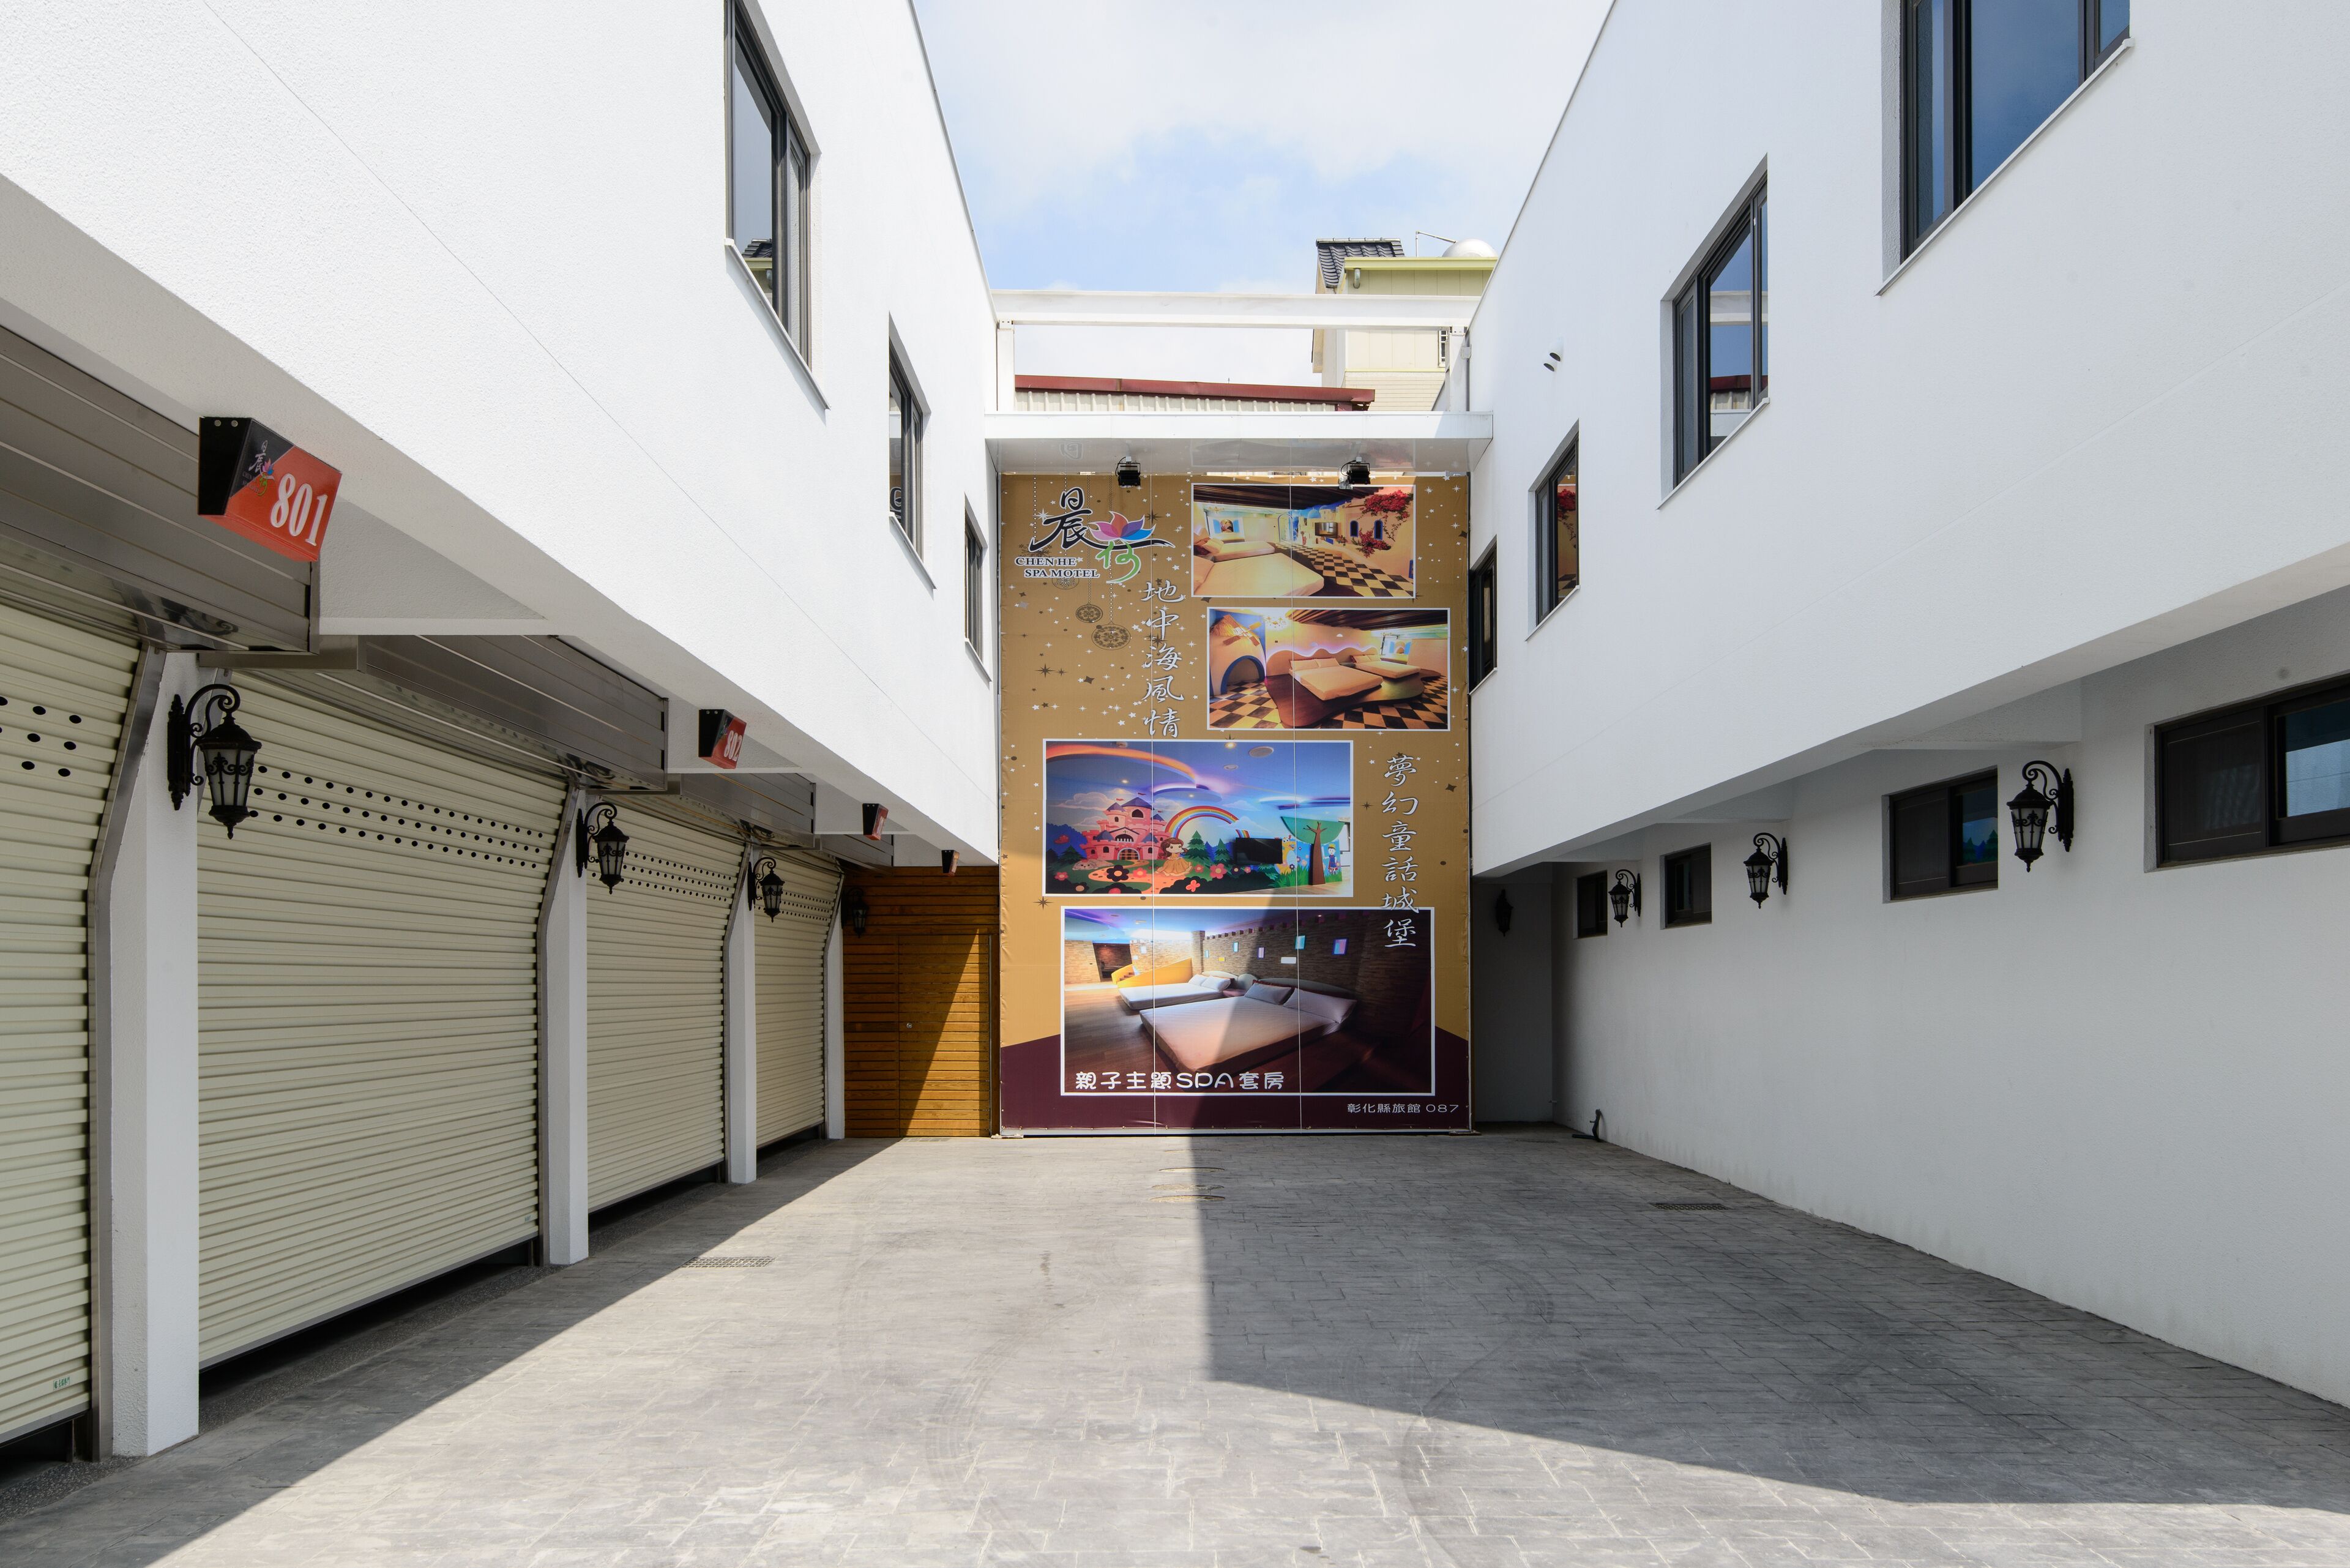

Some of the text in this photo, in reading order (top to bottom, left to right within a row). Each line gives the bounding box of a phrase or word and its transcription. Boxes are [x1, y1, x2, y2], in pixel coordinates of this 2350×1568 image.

[270, 473, 328, 547] 801
[1015, 556, 1076, 566] CHEN HE
[1024, 569, 1100, 578] SPA MOTEL
[1140, 579, 1185, 738] 地中海風情
[724, 730, 742, 761] 802
[1381, 753, 1420, 948] 夢幻童話城堡
[1075, 1071, 1285, 1090] 親子主題SPA套房
[1347, 1103, 1459, 1113] 彰化縣旅館 087
